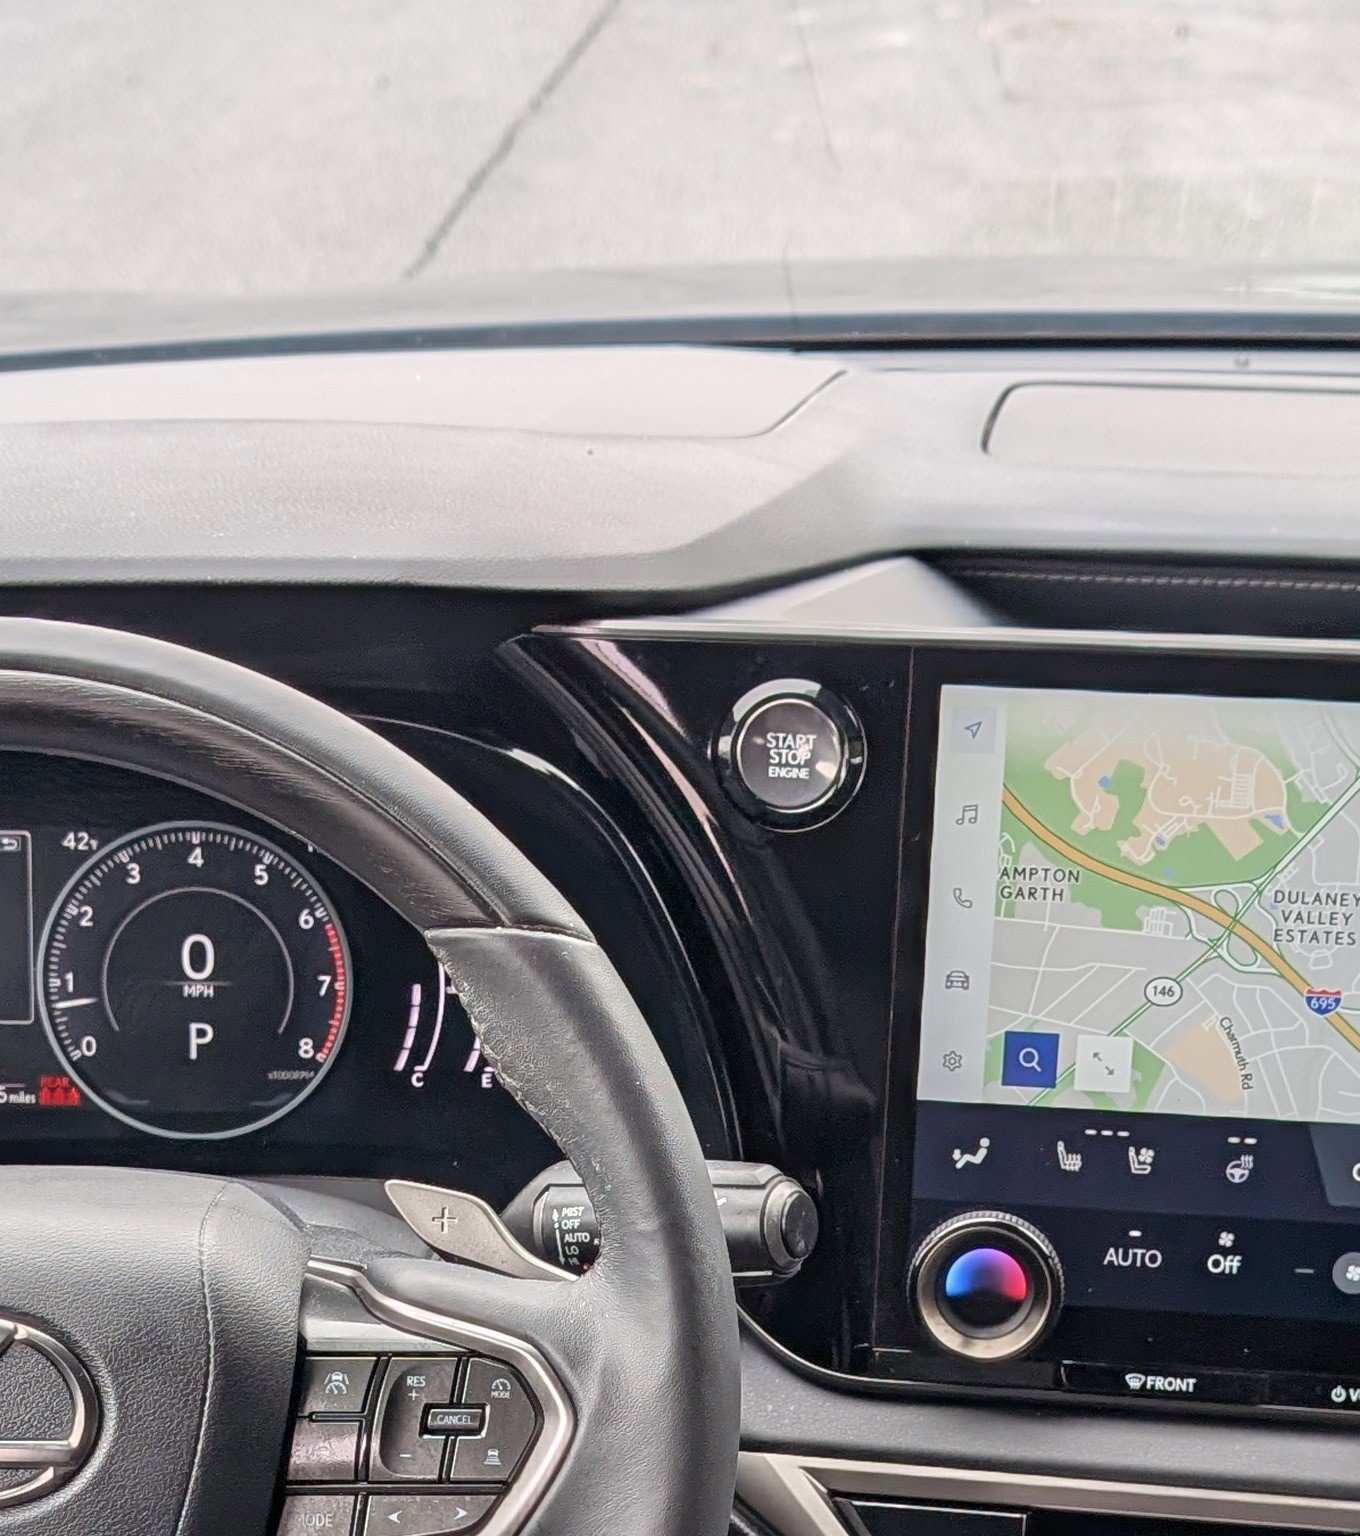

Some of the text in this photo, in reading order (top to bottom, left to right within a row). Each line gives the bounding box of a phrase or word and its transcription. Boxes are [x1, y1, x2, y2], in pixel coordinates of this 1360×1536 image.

[766, 732, 817, 749] START
[769, 749, 811, 765] STOP
[768, 766, 810, 779] ENGINE
[188, 847, 204, 867] 4
[126, 863, 141, 885] 3
[254, 865, 269, 886] 5
[999, 866, 1081, 885] AMPTON
[1000, 885, 1065, 903] GARTH
[79, 906, 94, 927] 2
[298, 908, 315, 930] 6
[1280, 910, 1355, 928] VALLEY
[1272, 928, 1357, 947] ESTATES
[180, 933, 216, 981] 0
[64, 972, 75, 993] 1
[182, 984, 215, 999] MPH
[317, 975, 332, 997] 7
[1151, 983, 1176, 998] 146
[1310, 996, 1337, 1011] 695
[80, 1035, 98, 1058] 0
[189, 1021, 214, 1060] P
[297, 1037, 315, 1060] 8
[1220, 1016, 1254, 1091] Charmuth Rd
[410, 1073, 425, 1088] C
[481, 1073, 493, 1088] E
[8, 1091, 37, 1104] miles
[562, 1206, 585, 1217] MIST
[562, 1219, 581, 1230] OFF
[564, 1232, 591, 1244] AUTO
[1104, 1247, 1163, 1270] AUTO
[1207, 1253, 1242, 1276] Off
[406, 1375, 426, 1388] RES
[1147, 1374, 1197, 1393] FRONT
[436, 1413, 473, 1425] CANCEL
